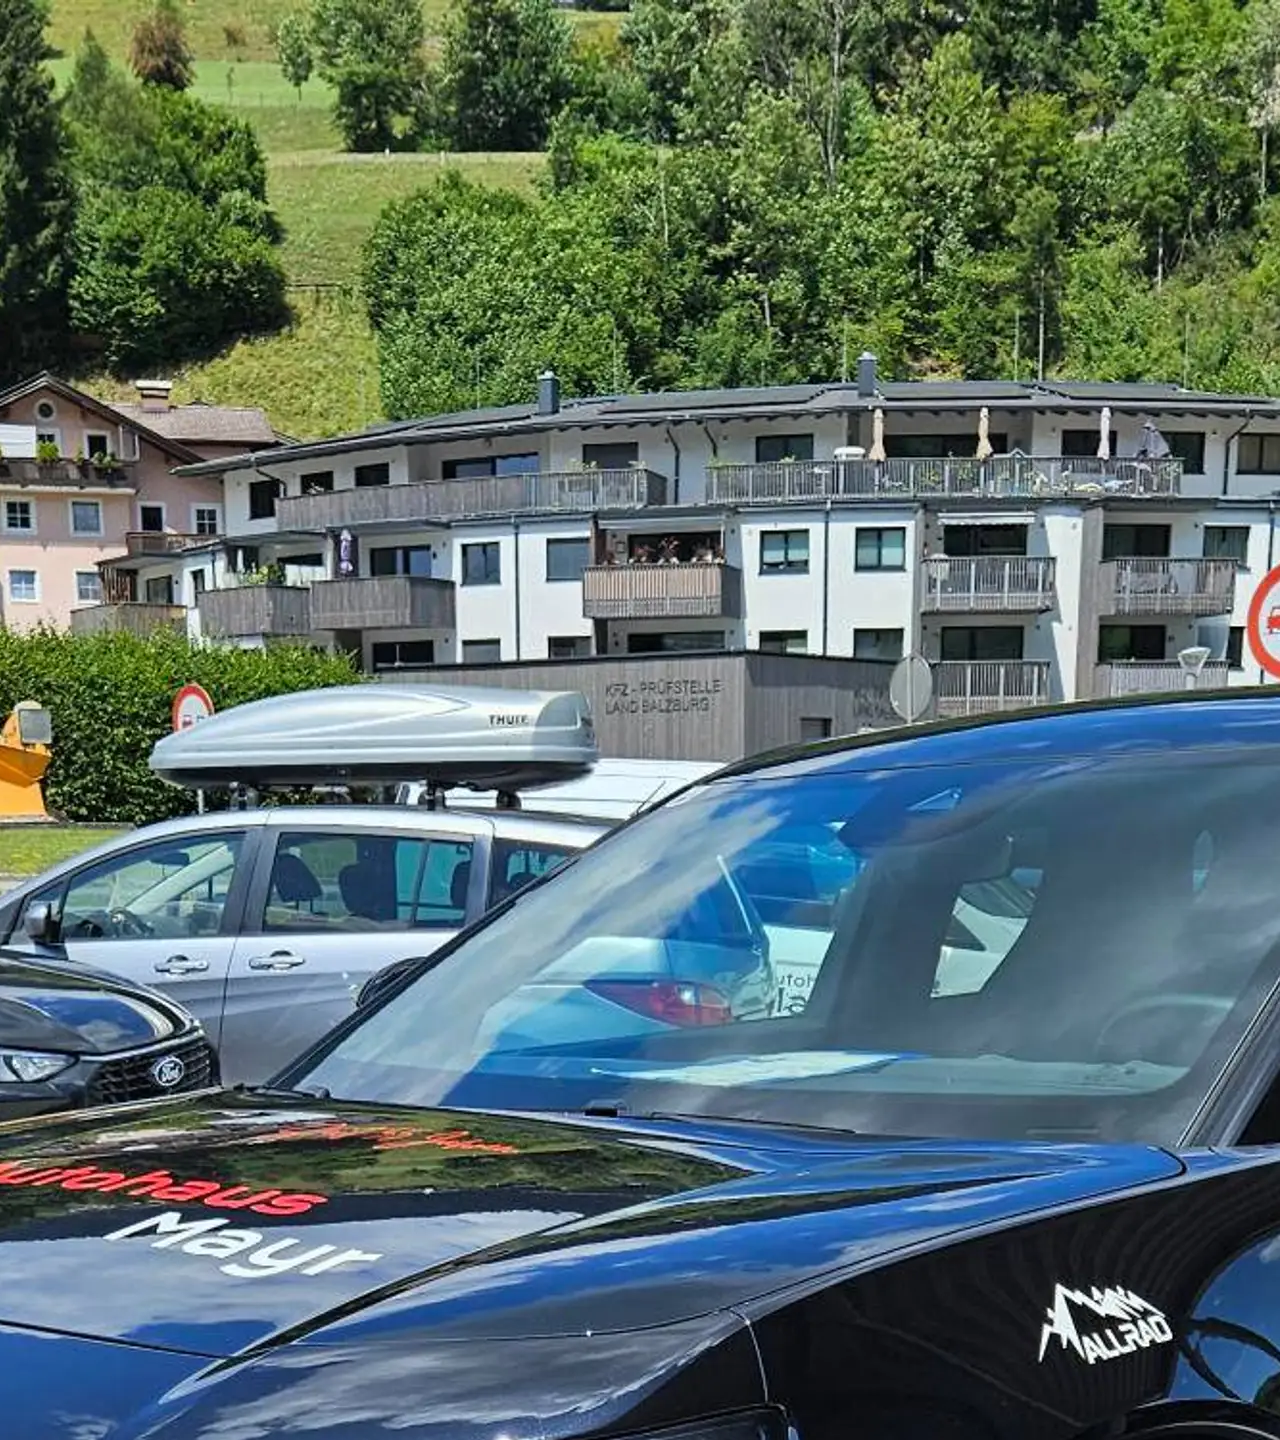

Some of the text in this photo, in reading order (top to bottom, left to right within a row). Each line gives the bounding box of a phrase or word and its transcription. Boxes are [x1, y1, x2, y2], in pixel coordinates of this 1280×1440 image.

[605, 700, 638, 715] LAND
[103, 1211, 382, 1278] Mayr
[1081, 1315, 1173, 1365] ALLRAD
